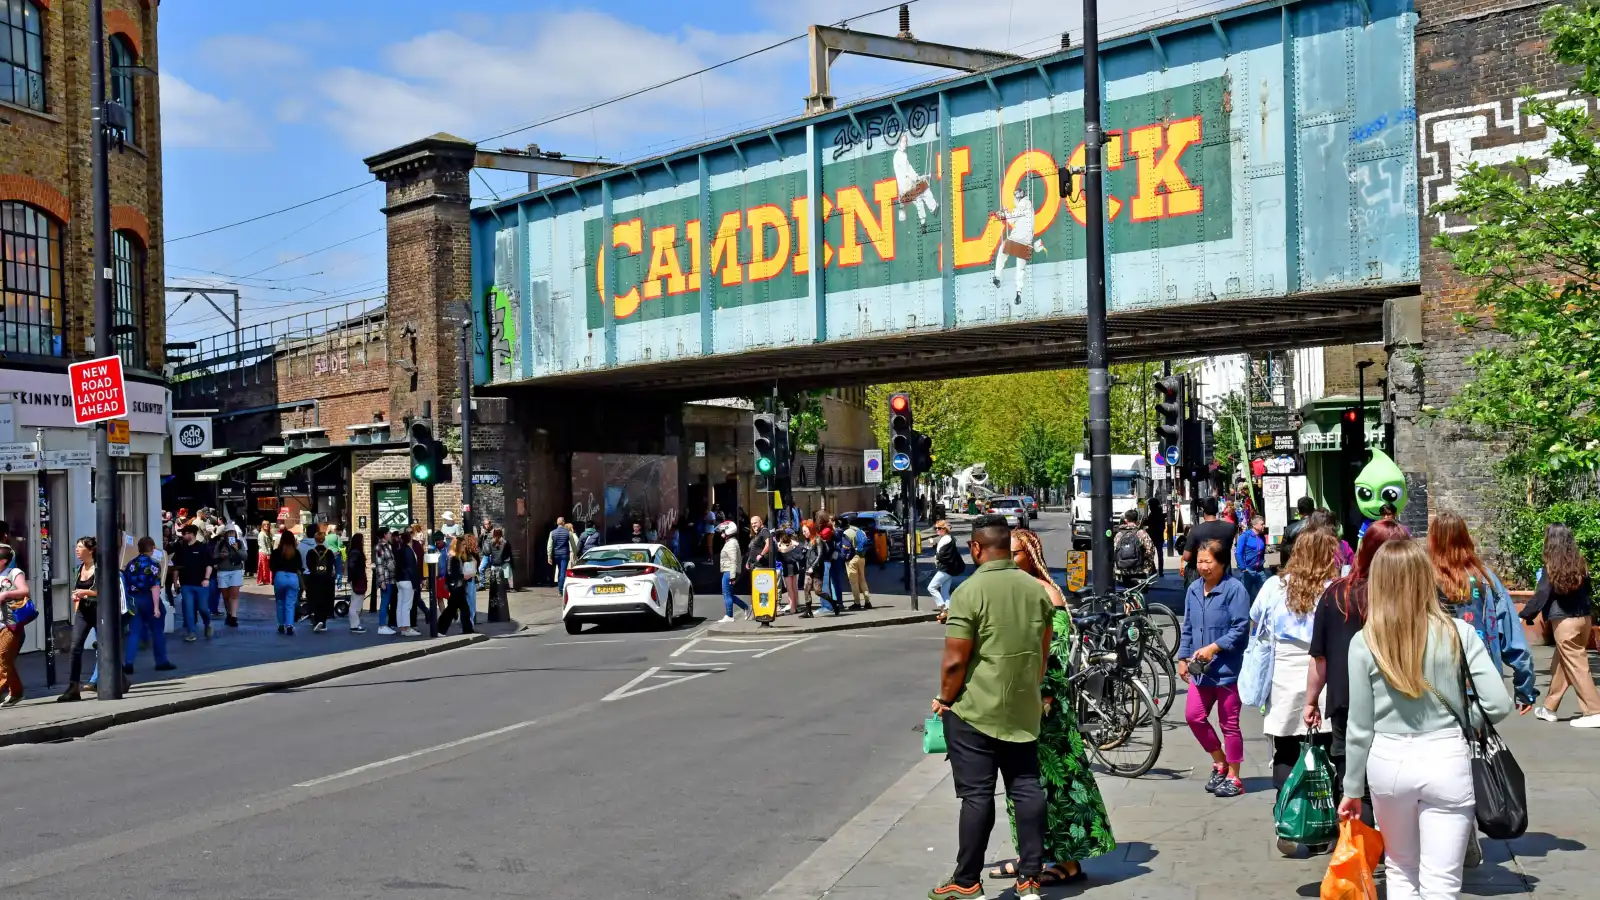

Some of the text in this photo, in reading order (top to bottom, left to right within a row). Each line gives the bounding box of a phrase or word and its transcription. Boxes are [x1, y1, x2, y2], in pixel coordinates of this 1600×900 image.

[596, 115, 1203, 319] CAMDEN LOCK
[82, 365, 108, 379] NEW
[81, 377, 112, 392] ROAD
[12, 391, 73, 407] SKINNYDI
[77, 387, 119, 405] LAYOUT
[81, 400, 119, 417] AHEAD
[183, 425, 201, 438] odd
[180, 435, 203, 446] balls
